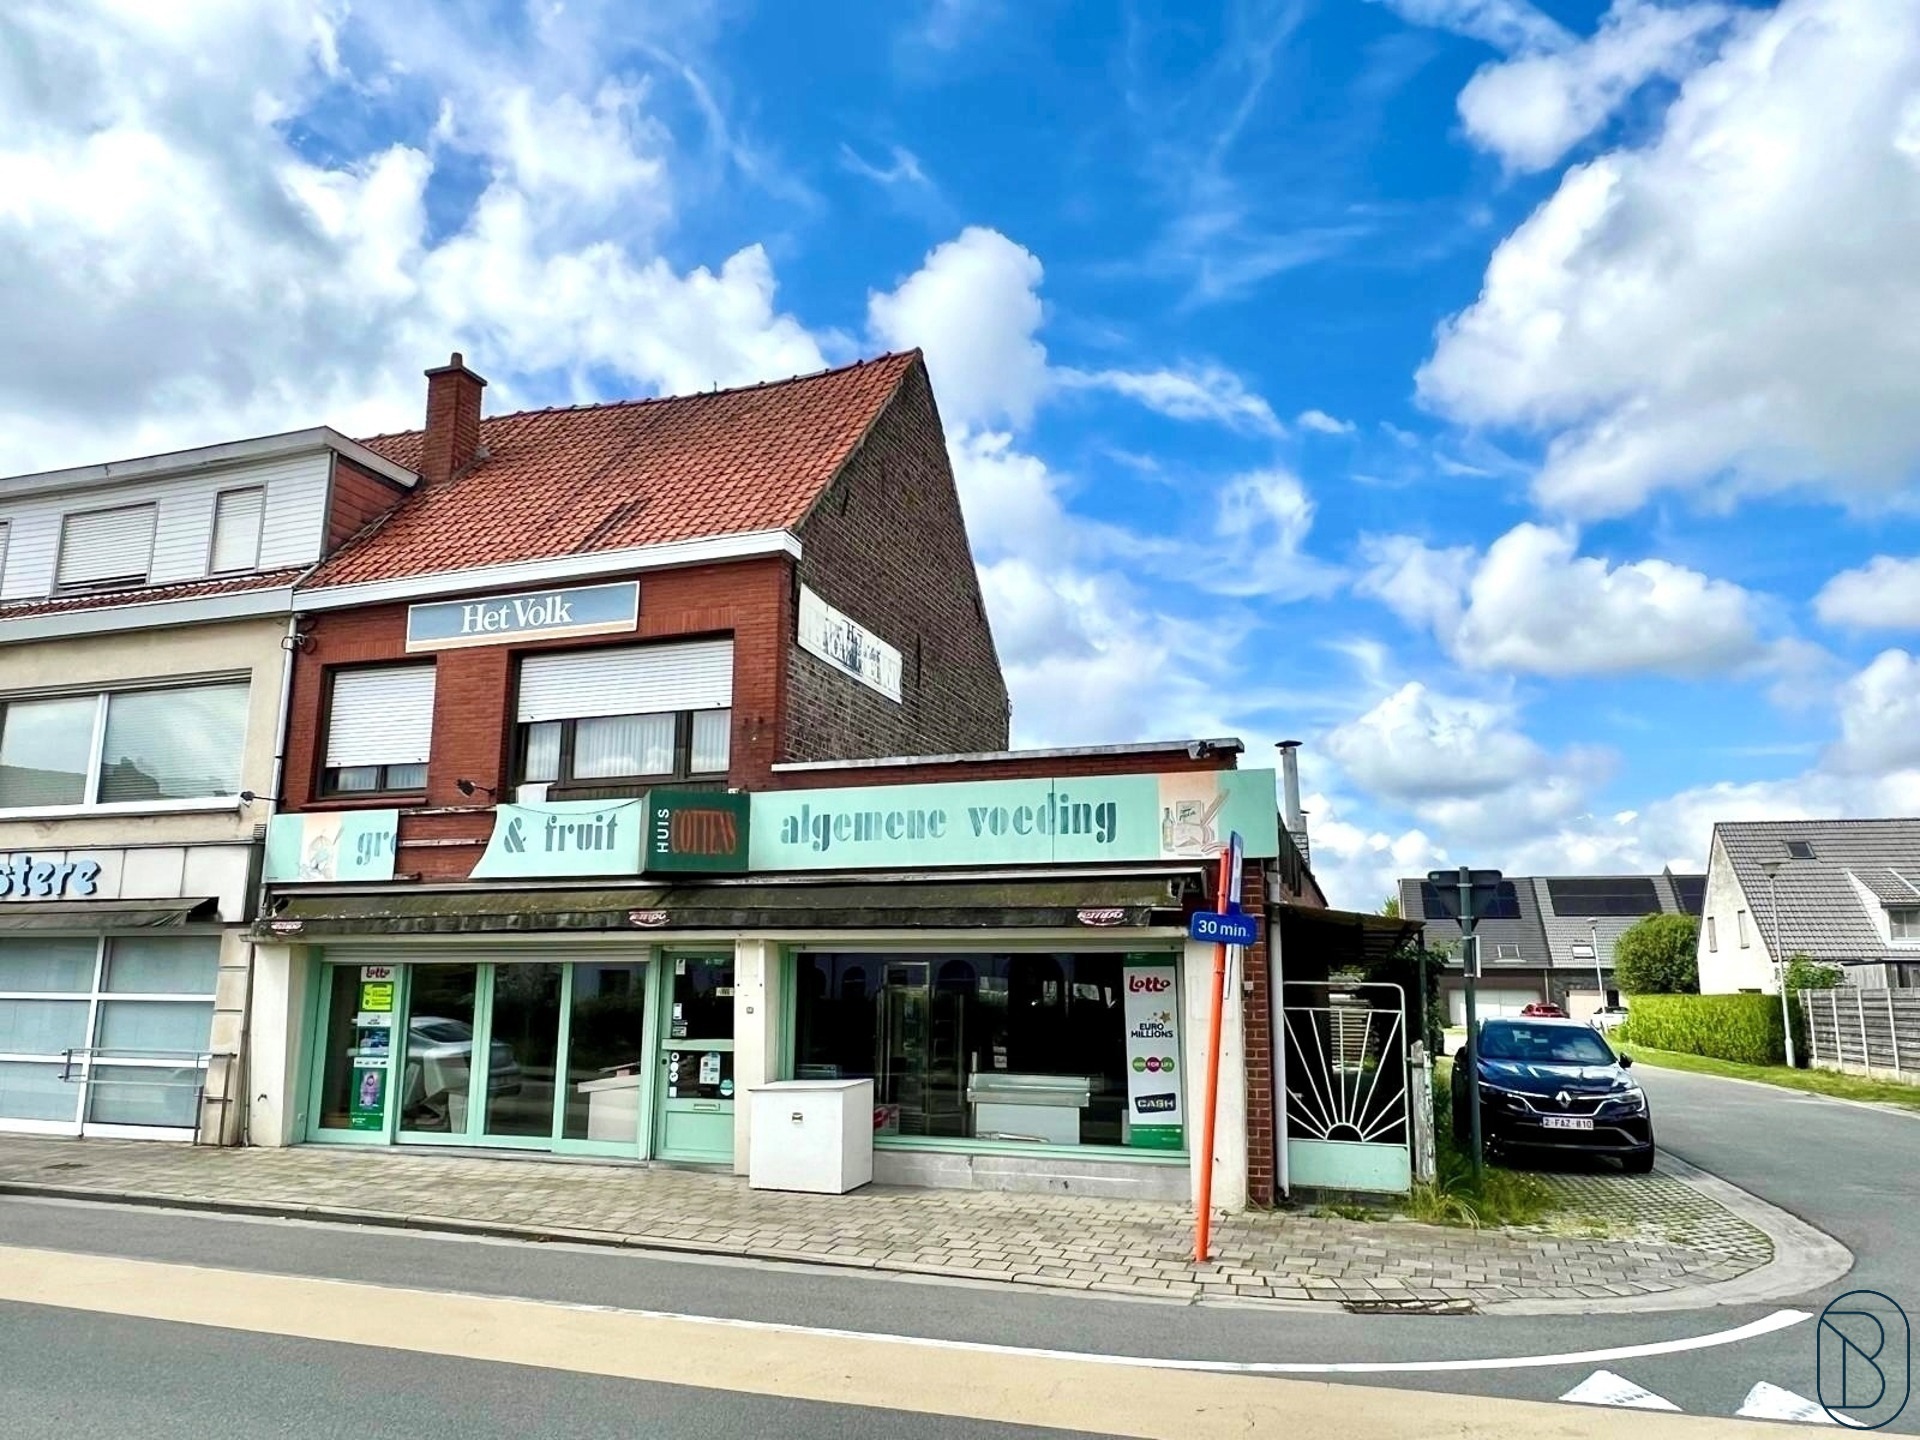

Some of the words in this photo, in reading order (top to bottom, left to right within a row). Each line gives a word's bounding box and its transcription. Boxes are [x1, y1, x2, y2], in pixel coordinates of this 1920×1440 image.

[460, 603, 510, 634] Het
[512, 595, 574, 627] Volk
[656, 808, 670, 853] HUIS
[780, 803, 948, 852] algemene
[966, 792, 1117, 844] voeding
[503, 816, 527, 853] &
[544, 812, 619, 852] fruit
[1198, 919, 1218, 934] 30
[1220, 923, 1251, 937] min.
[1128, 974, 1171, 993] Lotto
[1131, 1029, 1174, 1039] MILLIONS
[1139, 1023, 1165, 1031] EURO
[1137, 1099, 1174, 1109] CASH
